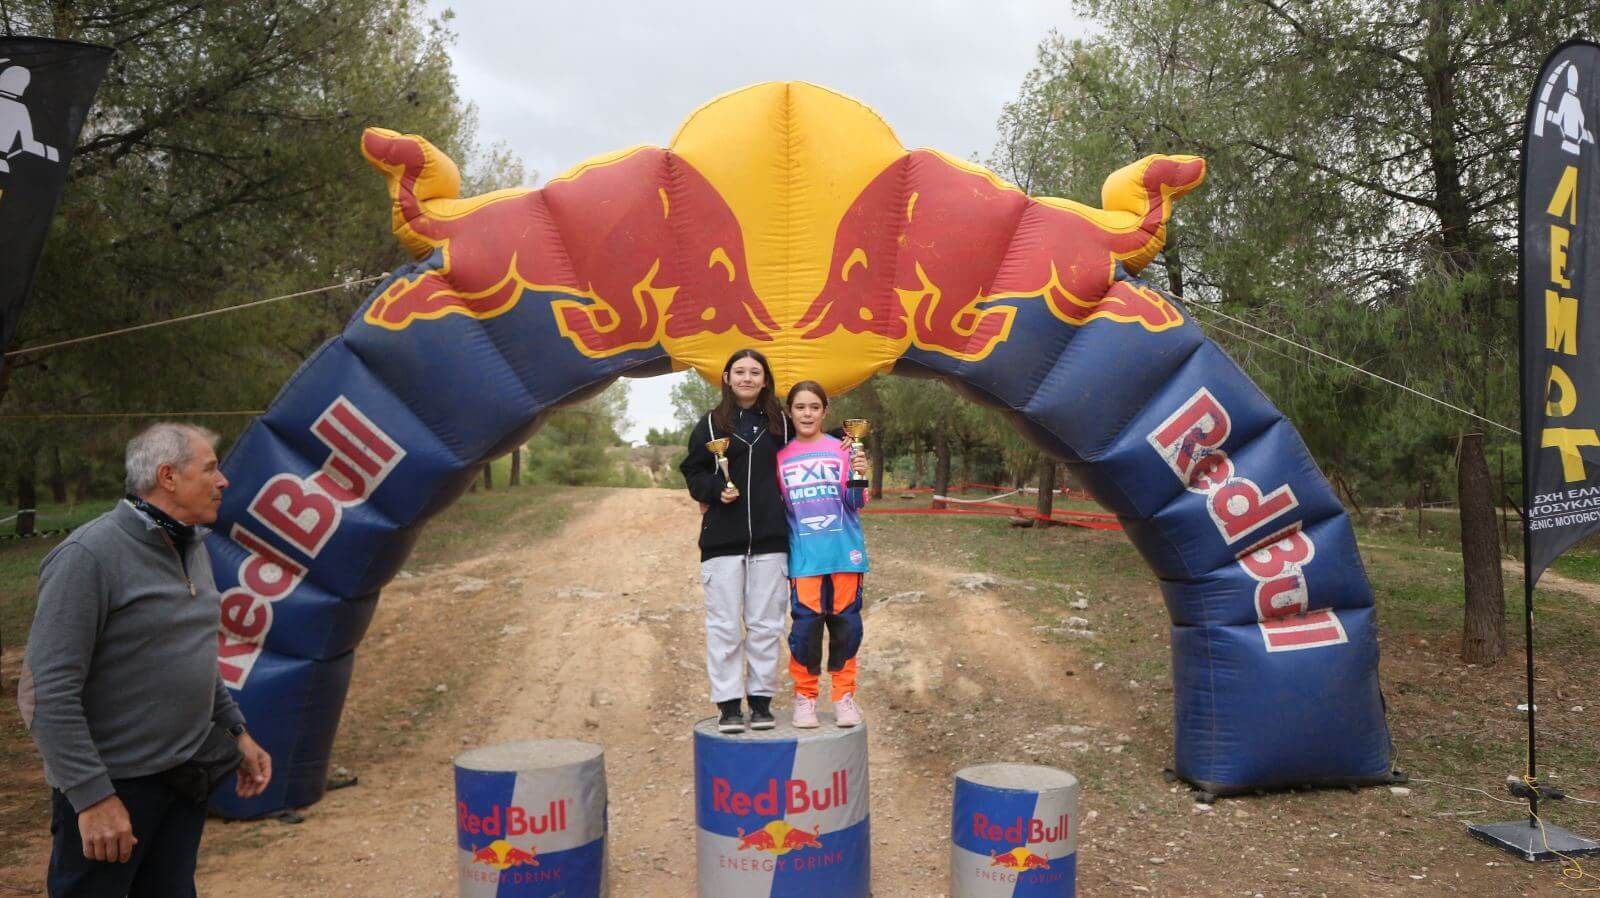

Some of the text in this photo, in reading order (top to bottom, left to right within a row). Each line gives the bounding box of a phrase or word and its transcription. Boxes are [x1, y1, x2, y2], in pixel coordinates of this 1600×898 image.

[247, 395, 407, 559] Bull
[783, 460, 840, 486] FXR
[789, 485, 839, 500] MOTO
[1146, 386, 1349, 652] Red Bull
[1530, 518, 1554, 531] ENIC
[712, 769, 848, 816] Red Bull
[456, 799, 567, 836] Red Bull
[973, 812, 1068, 844] Red Bull
[719, 850, 843, 872] ENERGY DRINK
